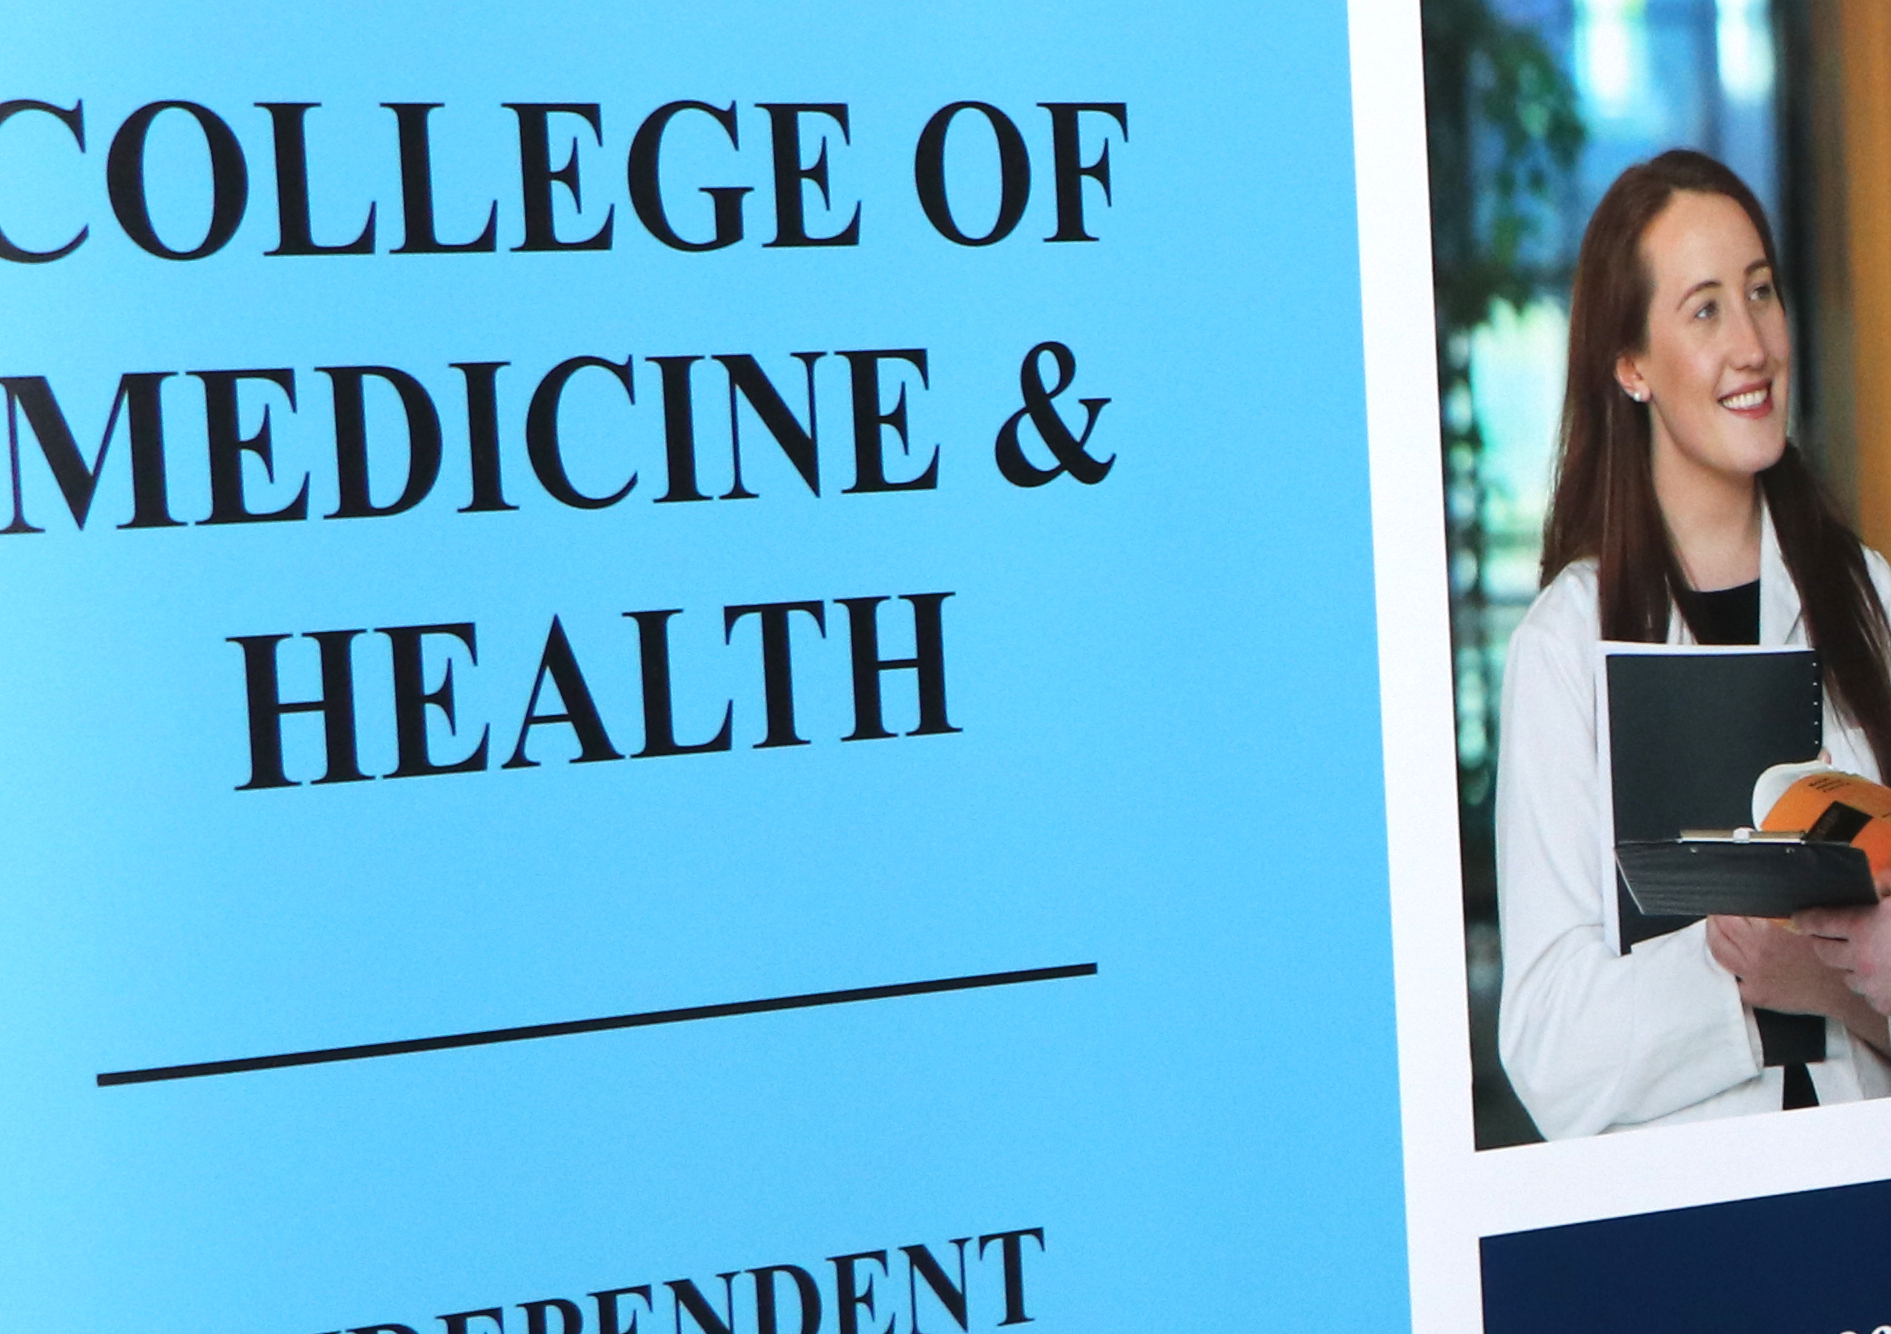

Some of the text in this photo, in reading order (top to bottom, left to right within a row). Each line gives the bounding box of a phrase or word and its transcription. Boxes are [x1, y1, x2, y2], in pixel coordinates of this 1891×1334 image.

[0, 97, 1131, 265] COLLEGE OF
[0, 339, 1119, 535] MEDICINE &
[224, 591, 964, 792] HEALTH
